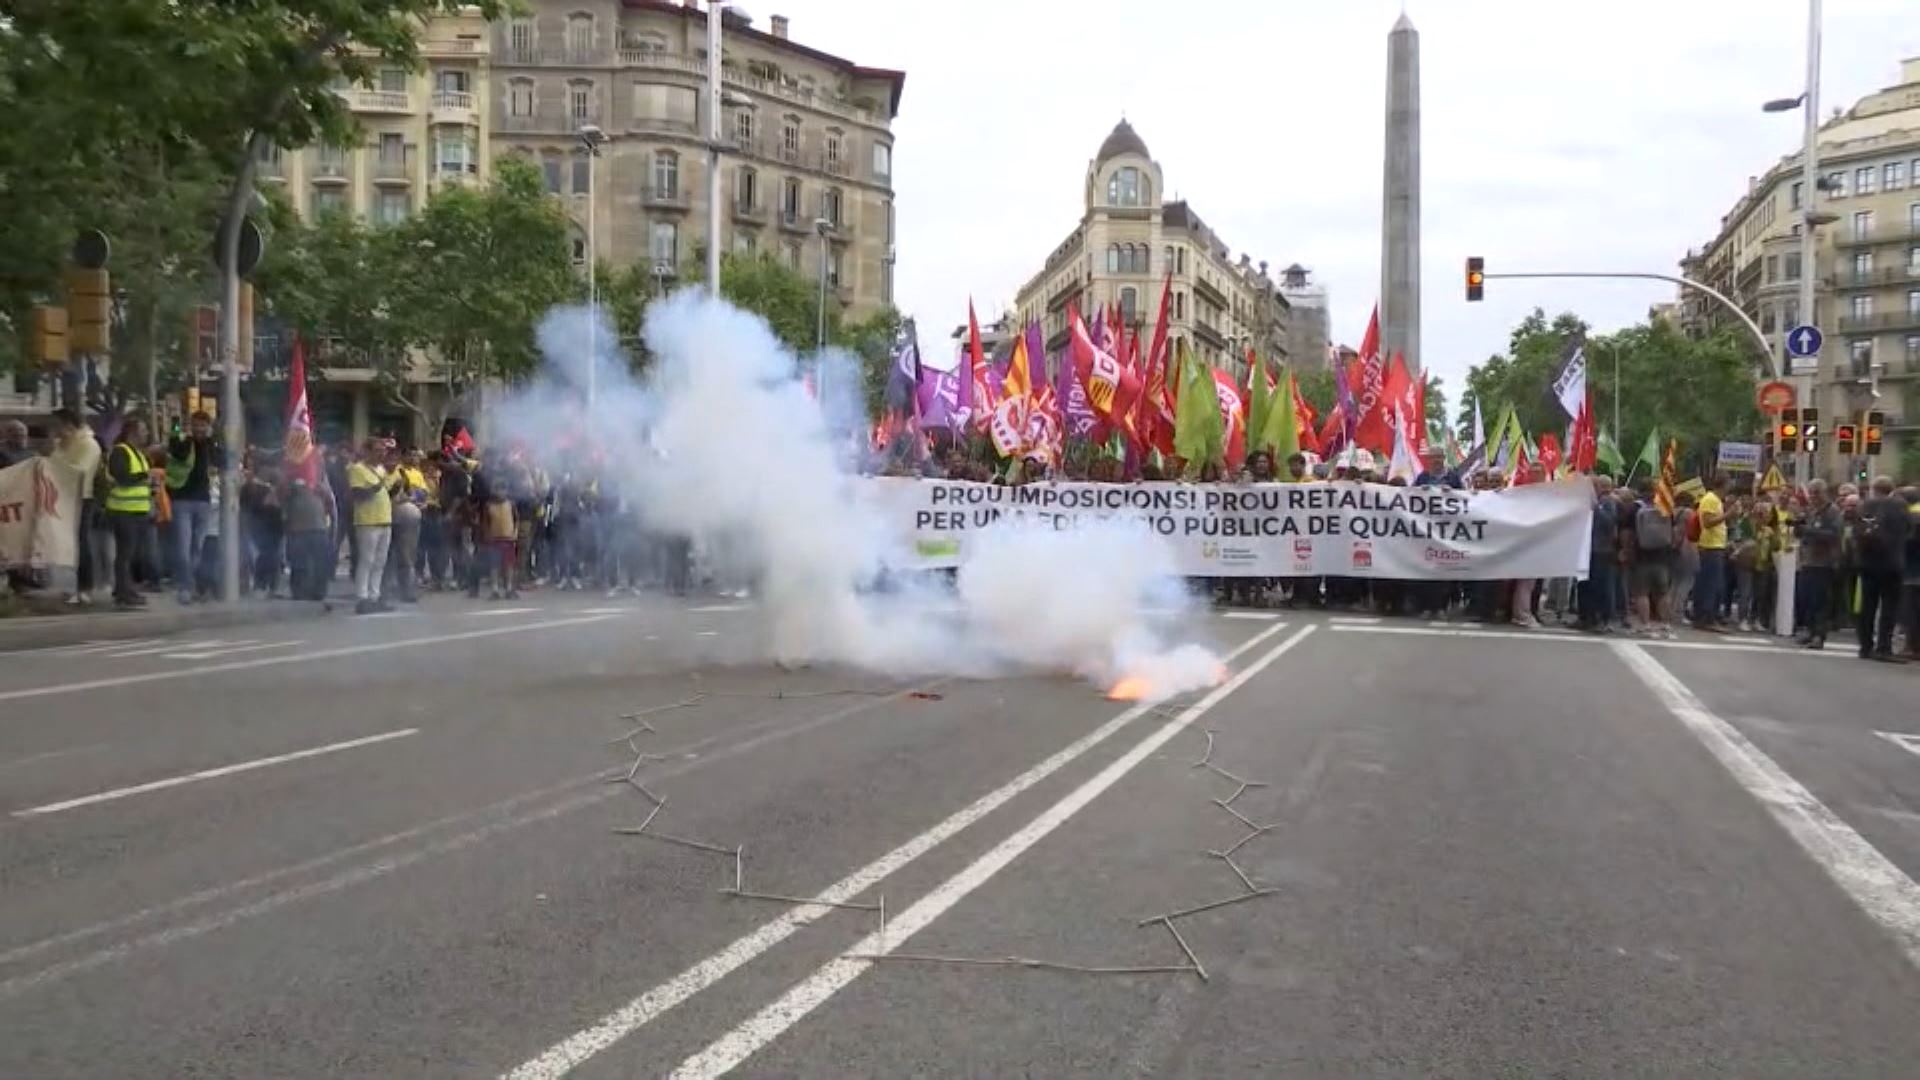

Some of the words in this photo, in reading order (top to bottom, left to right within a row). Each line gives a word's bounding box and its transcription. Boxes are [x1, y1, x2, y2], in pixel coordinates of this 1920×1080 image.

[931, 485, 1003, 506] PROU
[1010, 484, 1198, 511] IMPOSICIONS!
[1204, 489, 1280, 512] PROU
[1288, 488, 1470, 516] RETALLADES!
[915, 509, 966, 531] PER
[1183, 511, 1300, 537] PÚBLICA
[1307, 514, 1342, 536] DE
[1349, 515, 1488, 542] QUALITAT
